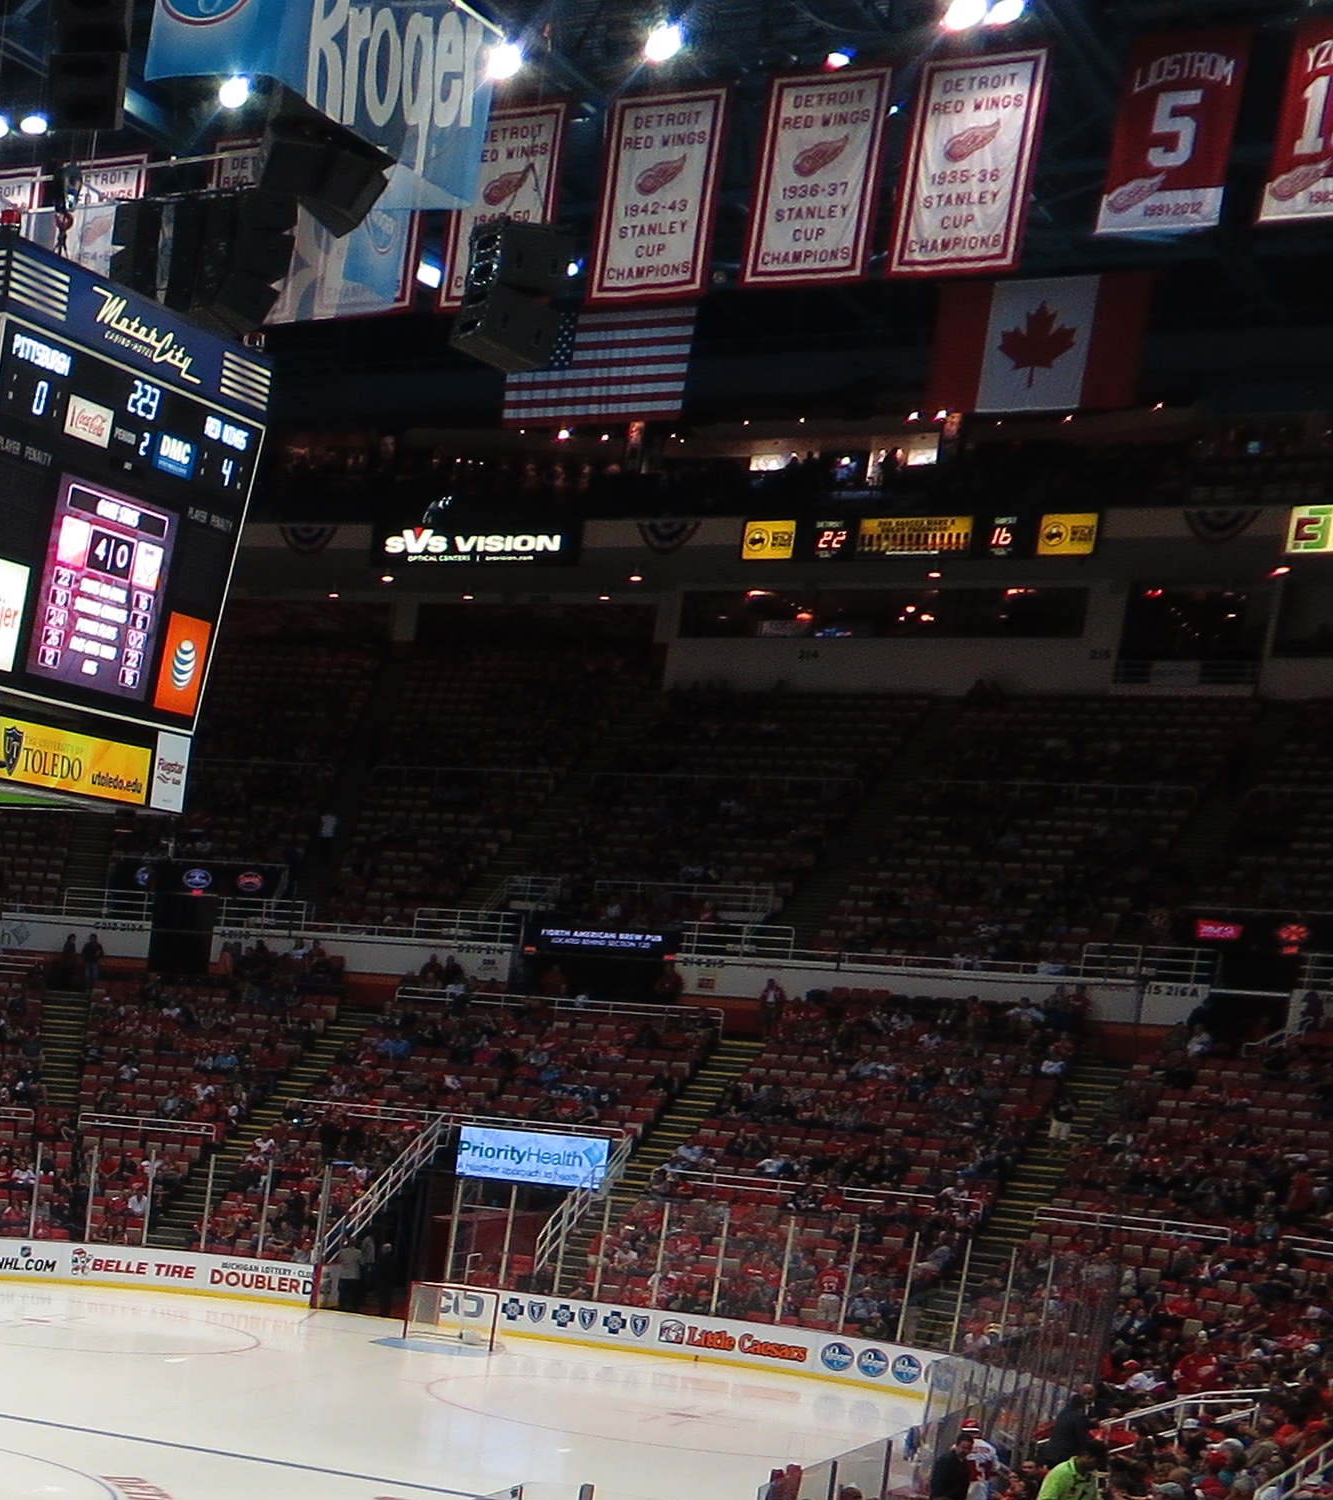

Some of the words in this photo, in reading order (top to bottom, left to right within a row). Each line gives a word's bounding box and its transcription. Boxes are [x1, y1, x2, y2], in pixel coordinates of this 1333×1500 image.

[305, 0, 488, 176] Kroger
[942, 73, 1017, 94] DETROIT
[792, 89, 867, 109] DETROIT
[932, 99, 965, 115] RED
[973, 94, 1025, 111] WINGS
[633, 110, 702, 130] DETROIT
[782, 112, 814, 131] RED
[821, 109, 871, 128] WINGS
[1147, 88, 1205, 168] 5
[505, 141, 550, 160] WINGS
[623, 133, 653, 151] RED
[661, 130, 707, 148] WINGS
[930, 168, 1001, 186] 1935-36
[782, 182, 850, 200] 1936-37
[923, 190, 1000, 210] STANLEY
[774, 204, 850, 222] STANLEY
[940, 214, 975, 231] CUP
[618, 219, 688, 240] STANLEY
[792, 228, 826, 243] CUP
[635, 244, 667, 258] CUP
[907, 233, 1003, 253] CHAMPIONS
[761, 246, 851, 266] CHAMPIONS
[607, 262, 691, 280] CHAMPIONS
[92, 284, 202, 386] MotorCity
[12, 333, 73, 377] PITTSBURGH
[31, 379, 49, 416] 0
[138, 432, 151, 458] 2
[159, 435, 194, 465] DMC
[23, 446, 54, 469] PENALTY
[453, 534, 563, 553] VISION
[817, 530, 849, 550] 22
[93, 537, 108, 561] 4
[115, 544, 130, 569] 0
[23, 746, 83, 782] TOLEDO
[158, 757, 186, 775] Flagstar
[91, 772, 144, 794] utoledo.edu
[458, 1140, 583, 1168] PriorityHealth
[91, 1258, 149, 1277] BELLE
[154, 1262, 199, 1281] TIRE
[221, 1261, 259, 1273] MICHIGAN
[260, 1265, 293, 1275] LOTTERY
[686, 1325, 736, 1354] Little
[738, 1333, 809, 1366] Caesars
